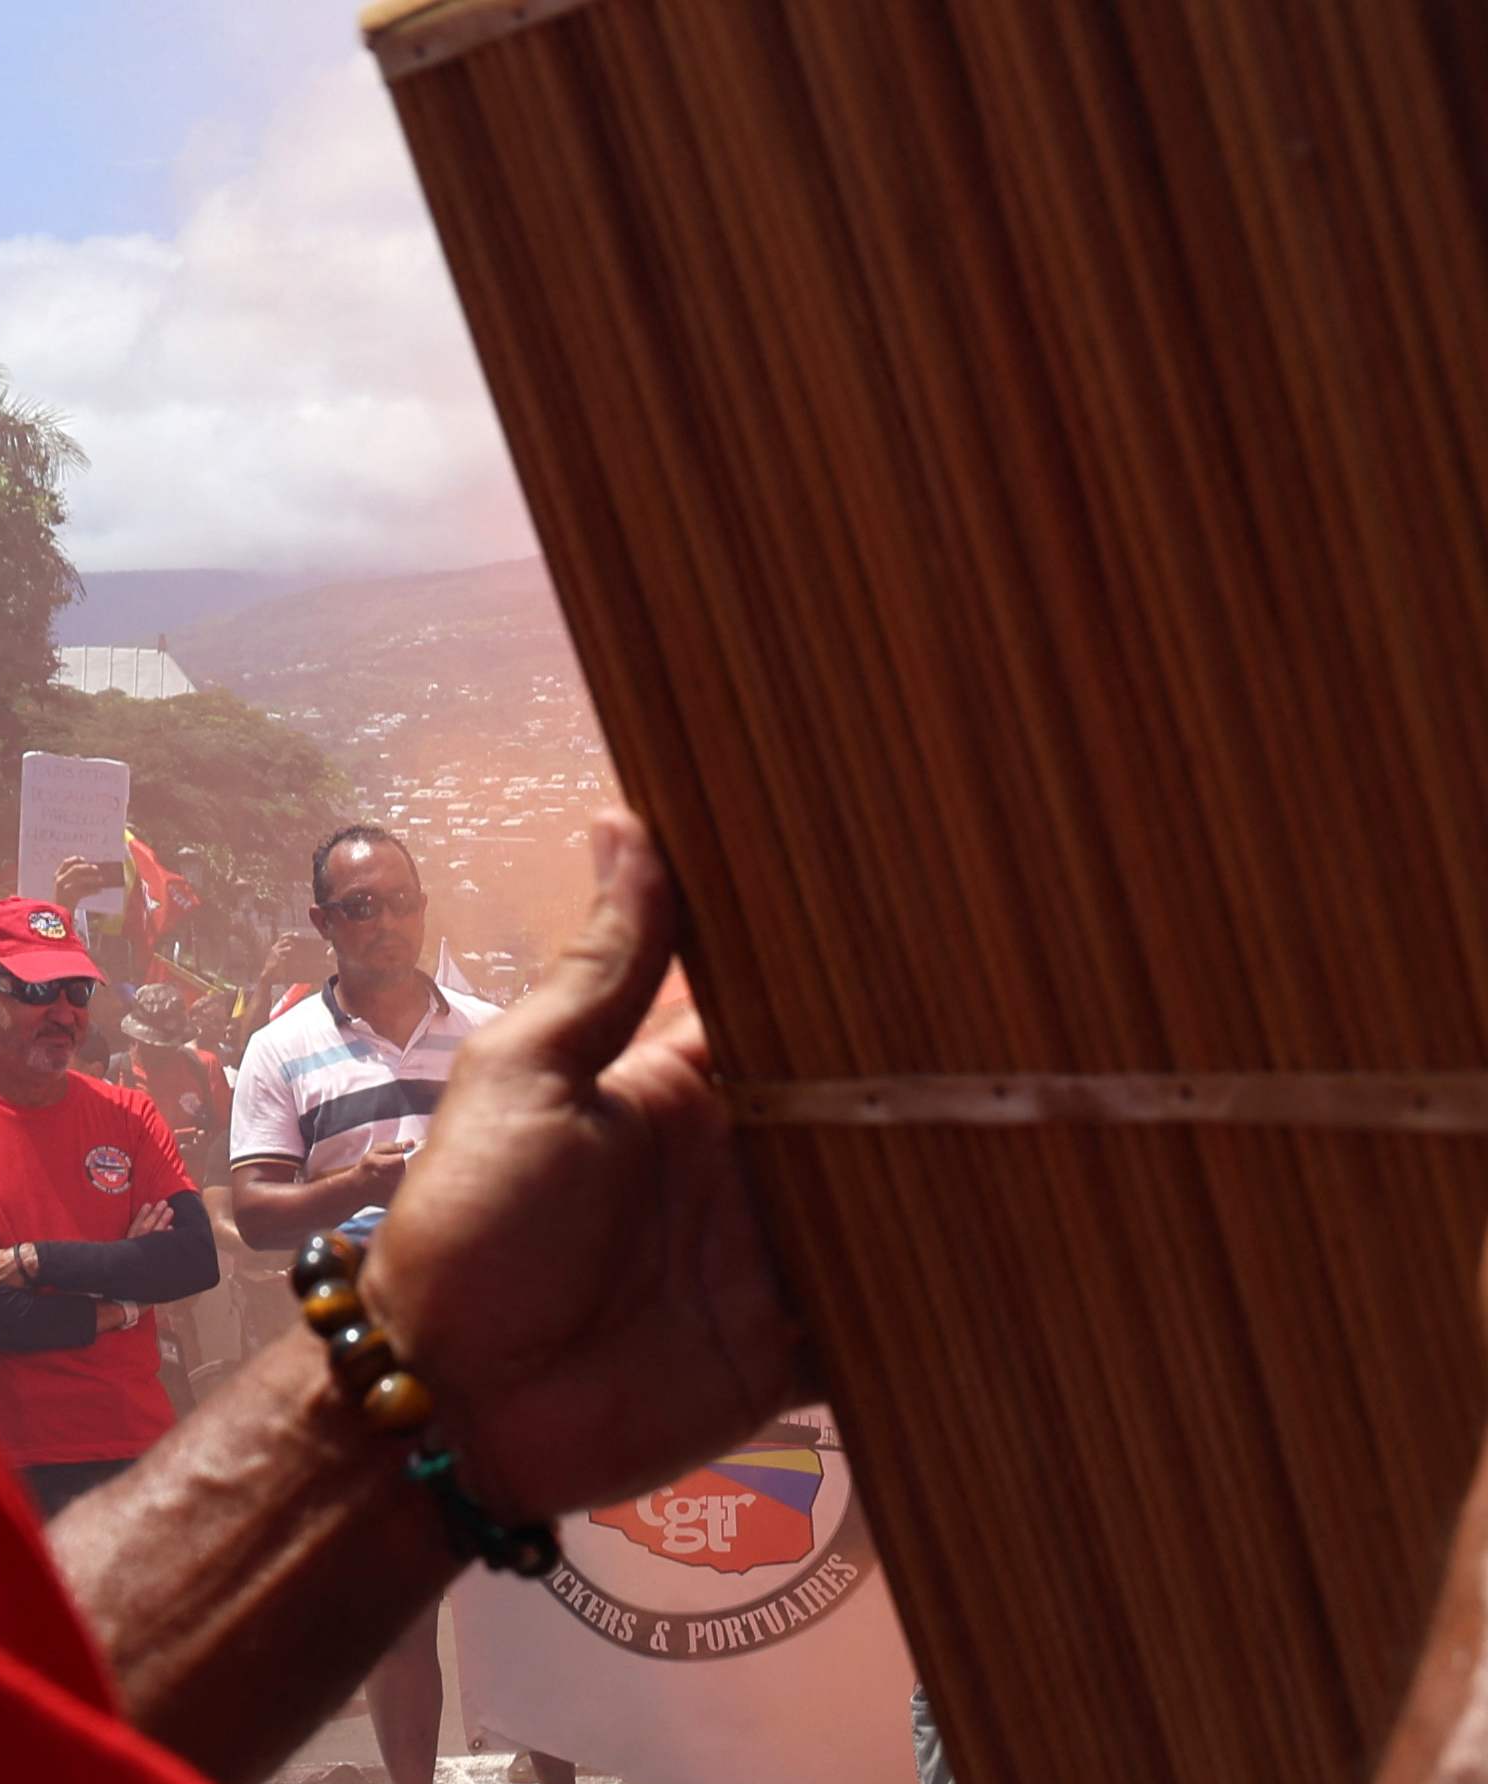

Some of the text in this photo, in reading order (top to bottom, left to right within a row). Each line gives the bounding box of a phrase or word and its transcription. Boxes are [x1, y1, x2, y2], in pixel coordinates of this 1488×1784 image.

[545, 1552, 859, 1653] CKERS & PORTUAIRES
